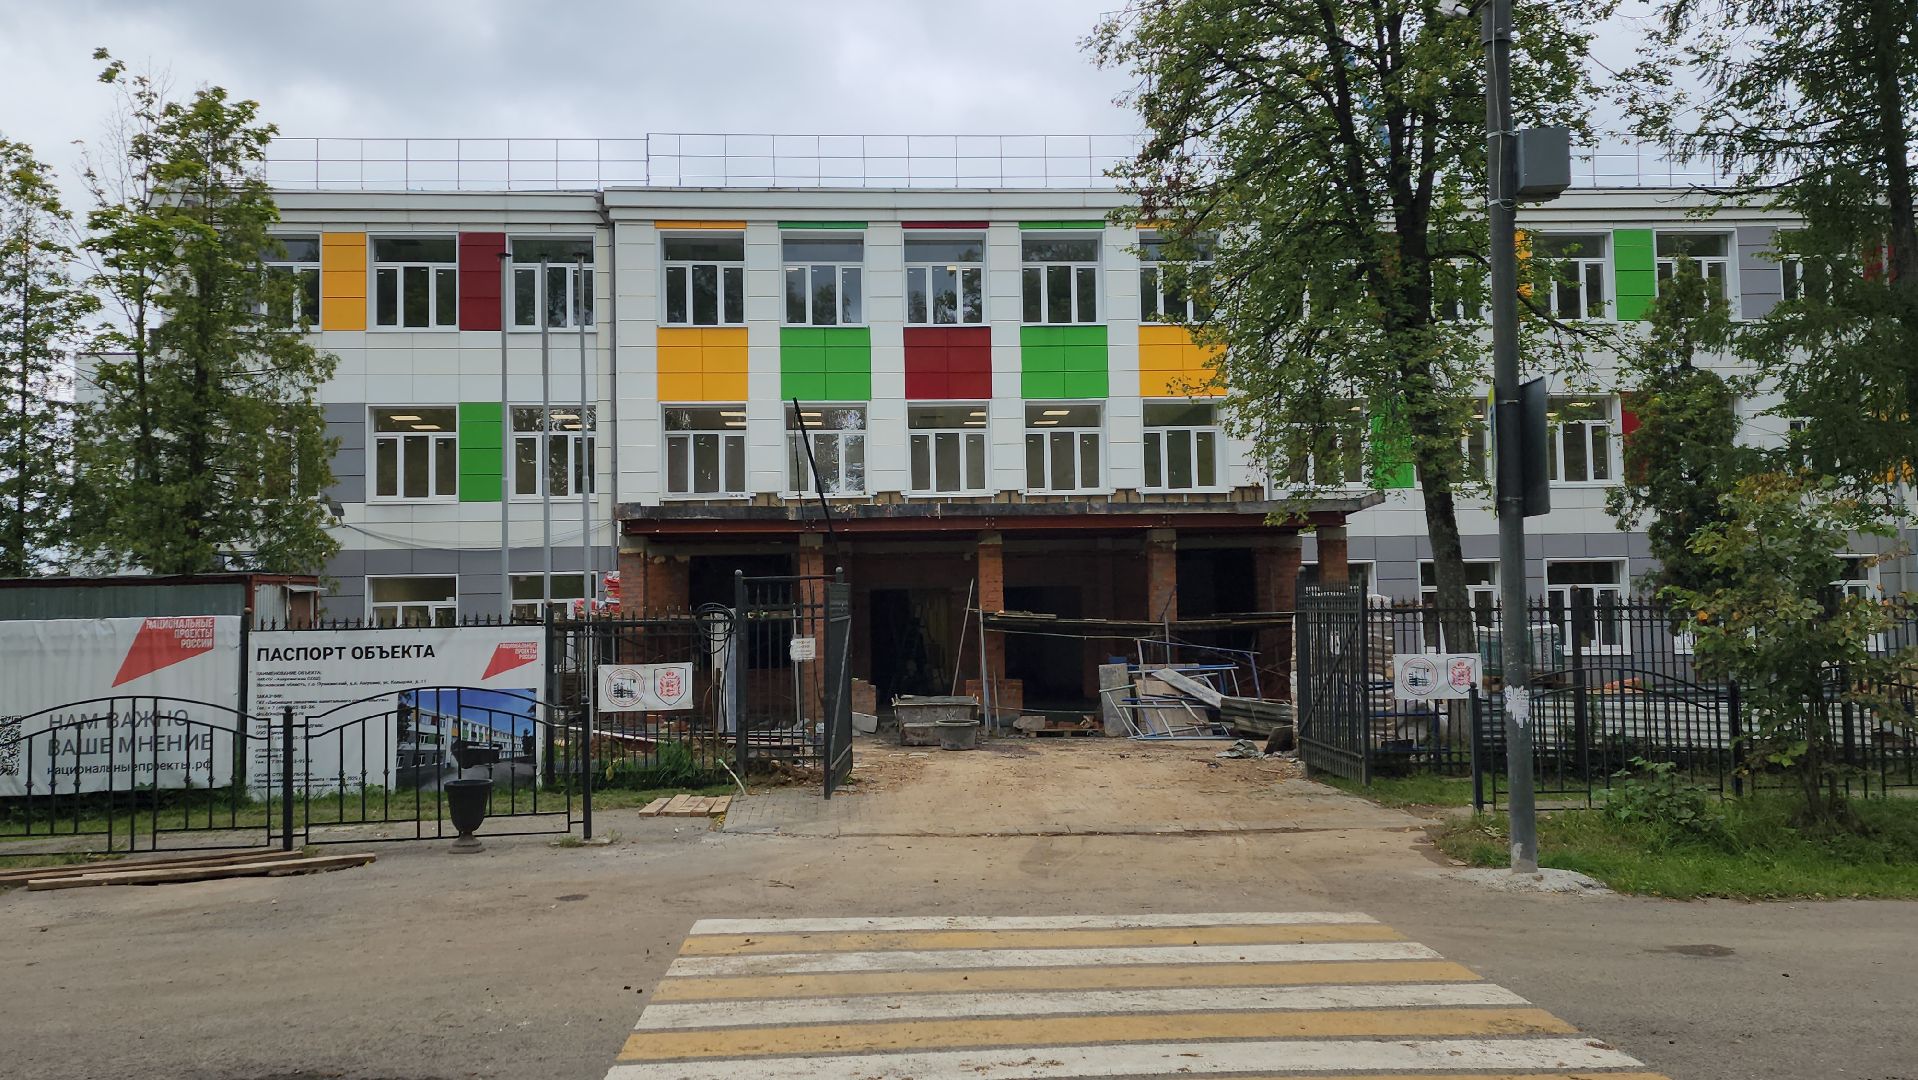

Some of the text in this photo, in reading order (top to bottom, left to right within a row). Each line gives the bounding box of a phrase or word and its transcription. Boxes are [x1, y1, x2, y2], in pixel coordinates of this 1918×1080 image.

[146, 618, 213, 630] НАЦИОНАЛЬНЫЕ
[174, 628, 213, 639] ПРОЕКТЫ
[180, 638, 213, 649] РОССИИ
[256, 644, 436, 662] ПАСПОРТ ОБЪЕКТА
[49, 708, 189, 731] НАМ ВАЖНО
[48, 733, 212, 757] ВАШЕ МНЕНИЕ
